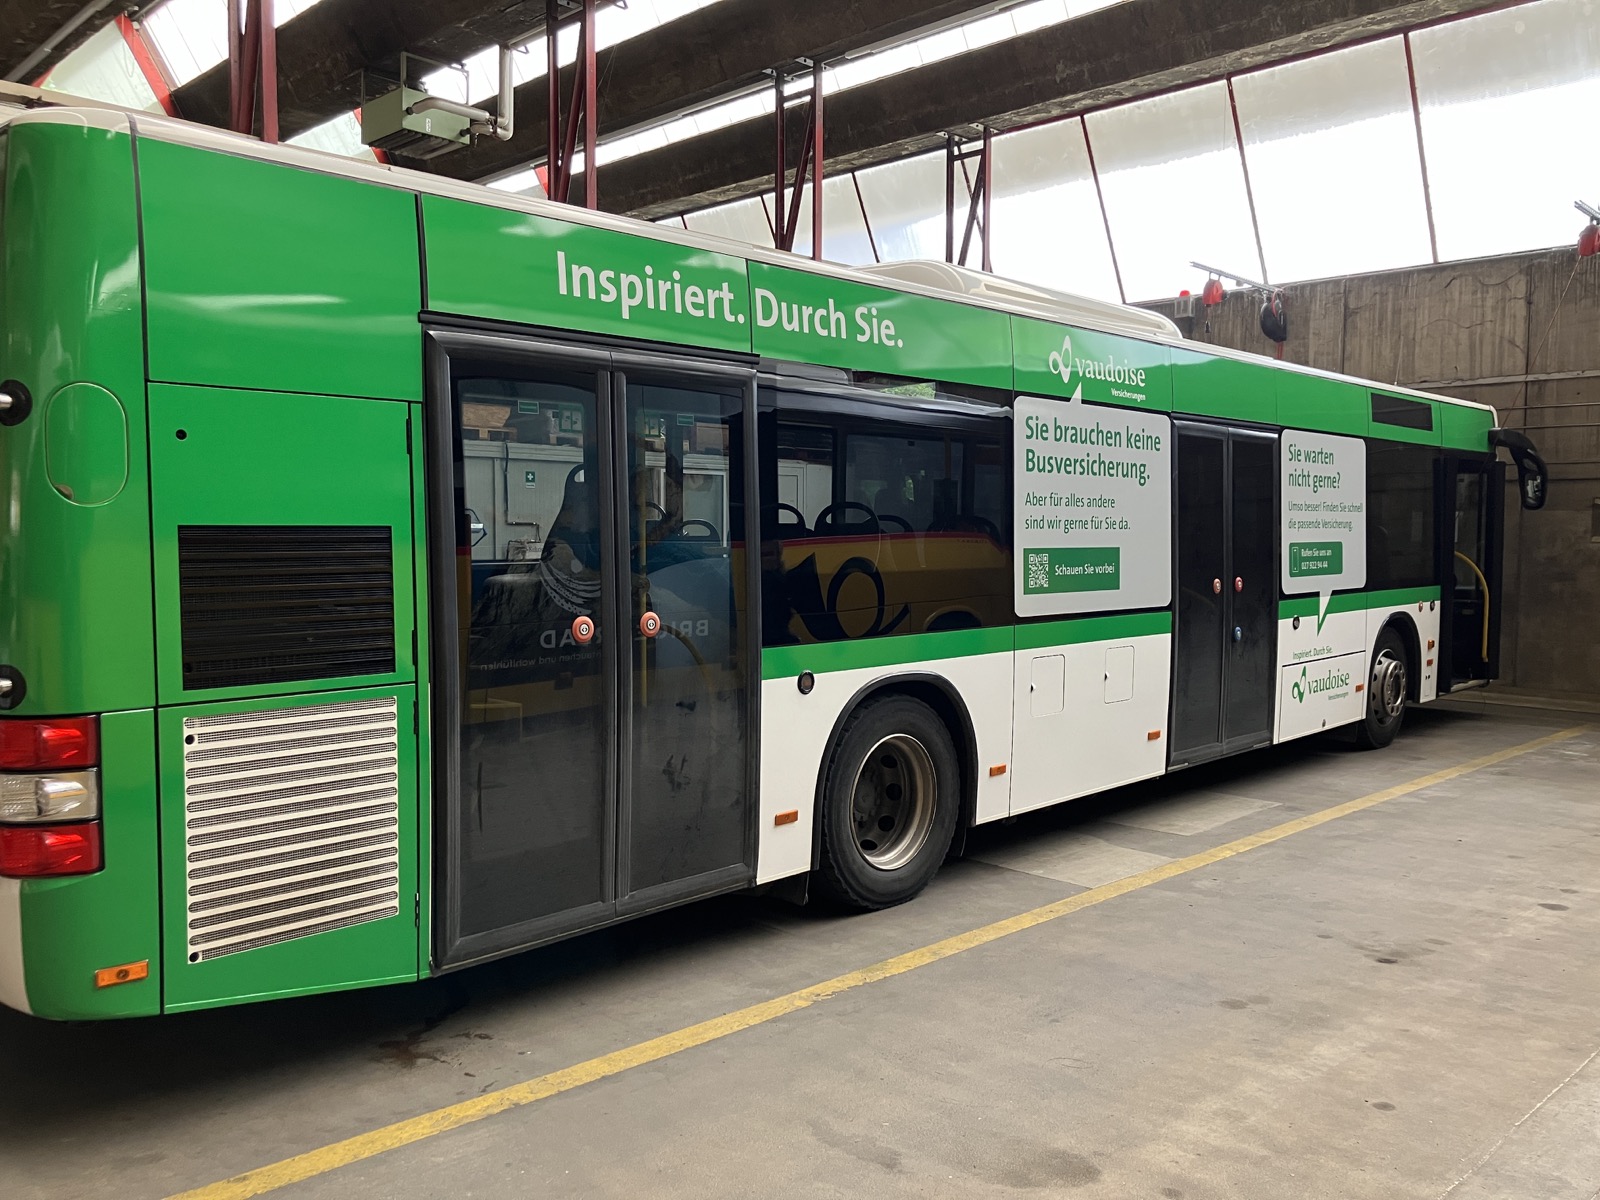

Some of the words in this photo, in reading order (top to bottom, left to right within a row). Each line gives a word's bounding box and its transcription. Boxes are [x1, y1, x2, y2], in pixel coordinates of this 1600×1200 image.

[557, 251, 745, 324] Inspiriert.
[755, 287, 847, 339] Durch
[855, 306, 904, 348] Sie.
[1075, 355, 1146, 387] vaudoise
[1111, 388, 1146, 402] Versicherungen
[1025, 415, 1049, 441] Sie
[1054, 417, 1122, 448] brauchen
[1126, 426, 1161, 451] keine
[1288, 443, 1302, 462] Sie
[1304, 447, 1334, 465] warten
[1025, 448, 1150, 486] Busversicherung.
[1288, 468, 1311, 487] nicht
[1312, 471, 1341, 493] gerne?
[1025, 492, 1047, 507] Aber
[1049, 492, 1063, 507] für
[1065, 493, 1085, 507] alles
[1087, 494, 1116, 508] andere
[1288, 501, 1303, 511] Umso
[1323, 501, 1338, 512] Finden
[1339, 502, 1347, 512] Sie
[1347, 502, 1363, 512] schnell
[1025, 515, 1045, 530] sind
[1047, 516, 1061, 530] wir
[1064, 519, 1088, 534] gerne
[1090, 516, 1103, 530] für
[1104, 517, 1117, 530] Sie
[1118, 517, 1131, 530] da.
[1288, 518, 1296, 529] die
[1297, 518, 1320, 532] passende
[1321, 519, 1353, 533] Versicherung.
[1055, 564, 1083, 575] Schauen
[1084, 563, 1094, 575] Sie
[1095, 563, 1115, 574] vorbei
[1307, 668, 1350, 695] vaudoise
